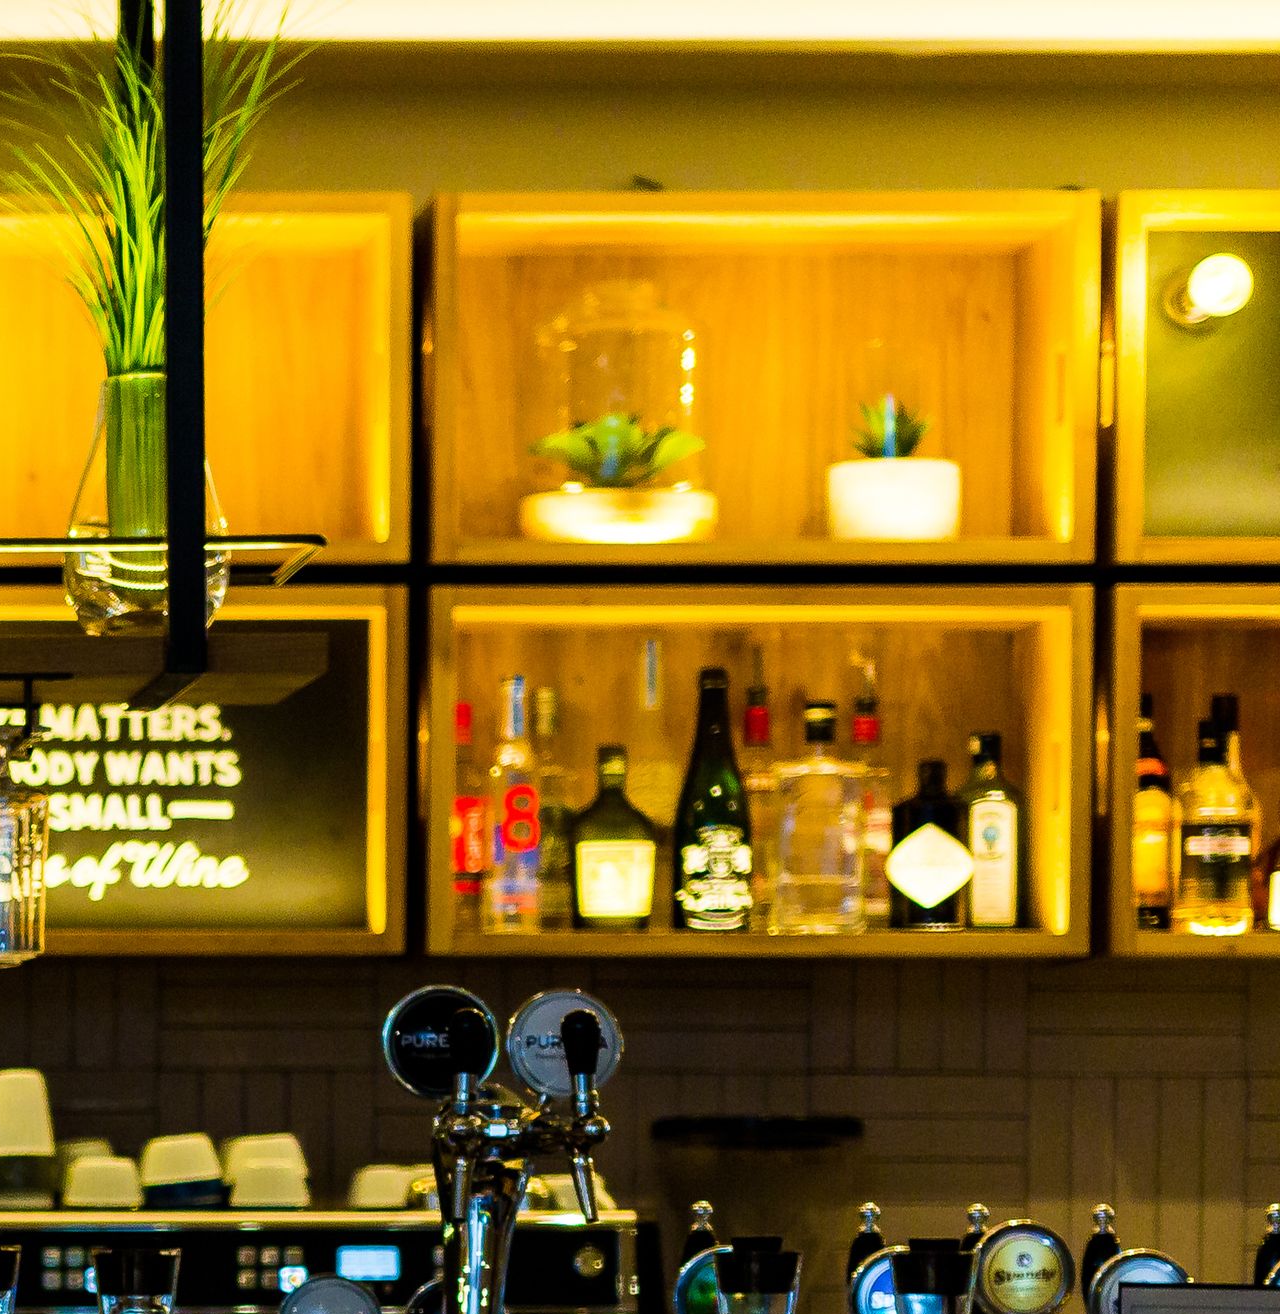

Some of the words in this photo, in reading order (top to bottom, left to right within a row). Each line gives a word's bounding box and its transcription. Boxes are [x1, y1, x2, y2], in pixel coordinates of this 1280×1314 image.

[40, 703, 232, 742] MATTERS.
[104, 749, 241, 787] WANTS
[48, 792, 172, 831] SMALL
[69, 841, 146, 902] of
[128, 842, 250, 889] Wine
[402, 1032, 450, 1049] PURE
